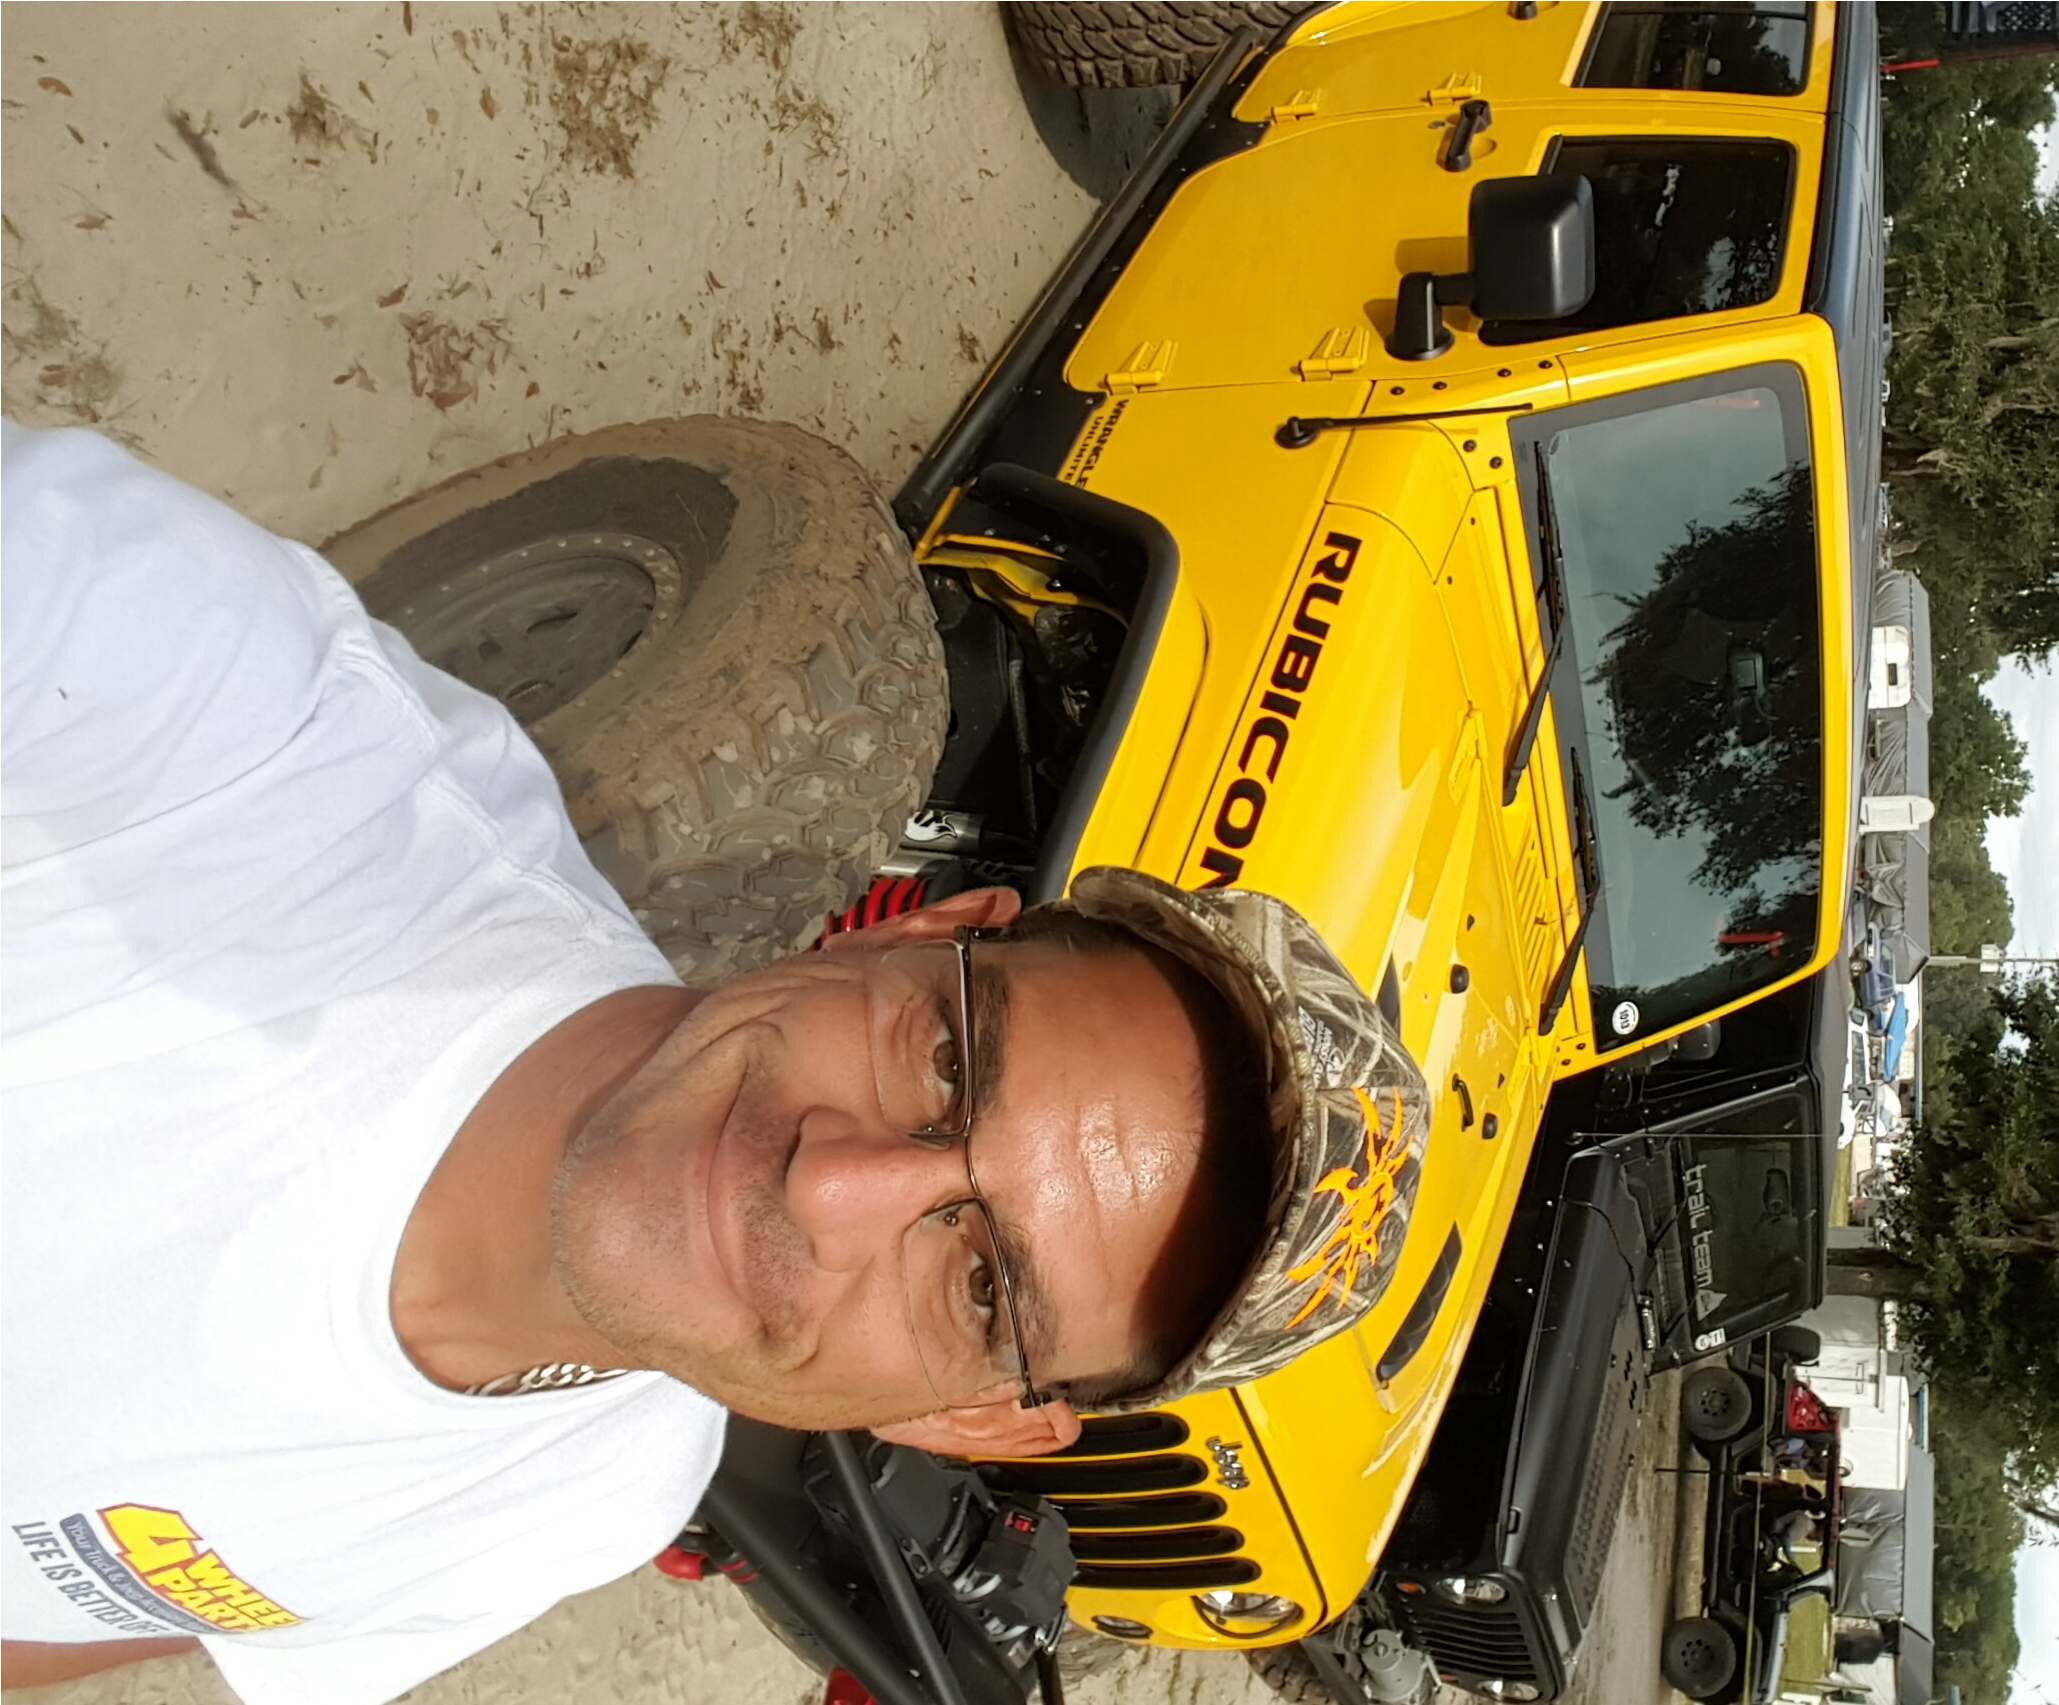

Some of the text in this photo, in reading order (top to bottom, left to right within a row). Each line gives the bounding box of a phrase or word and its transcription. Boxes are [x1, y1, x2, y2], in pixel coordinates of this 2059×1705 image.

[1064, 416, 1104, 482] UNLIMITE
[1074, 399, 1130, 489] WRANGLE
[1206, 1436, 1250, 1490] Jeep
[12, 1521, 68, 1562] LIFE
[67, 1521, 92, 1549] Your
[97, 1504, 203, 1574] 4
[40, 1563, 83, 1582] IS
[185, 1551, 305, 1630] WHEE
[57, 1580, 139, 1625] BETTER
